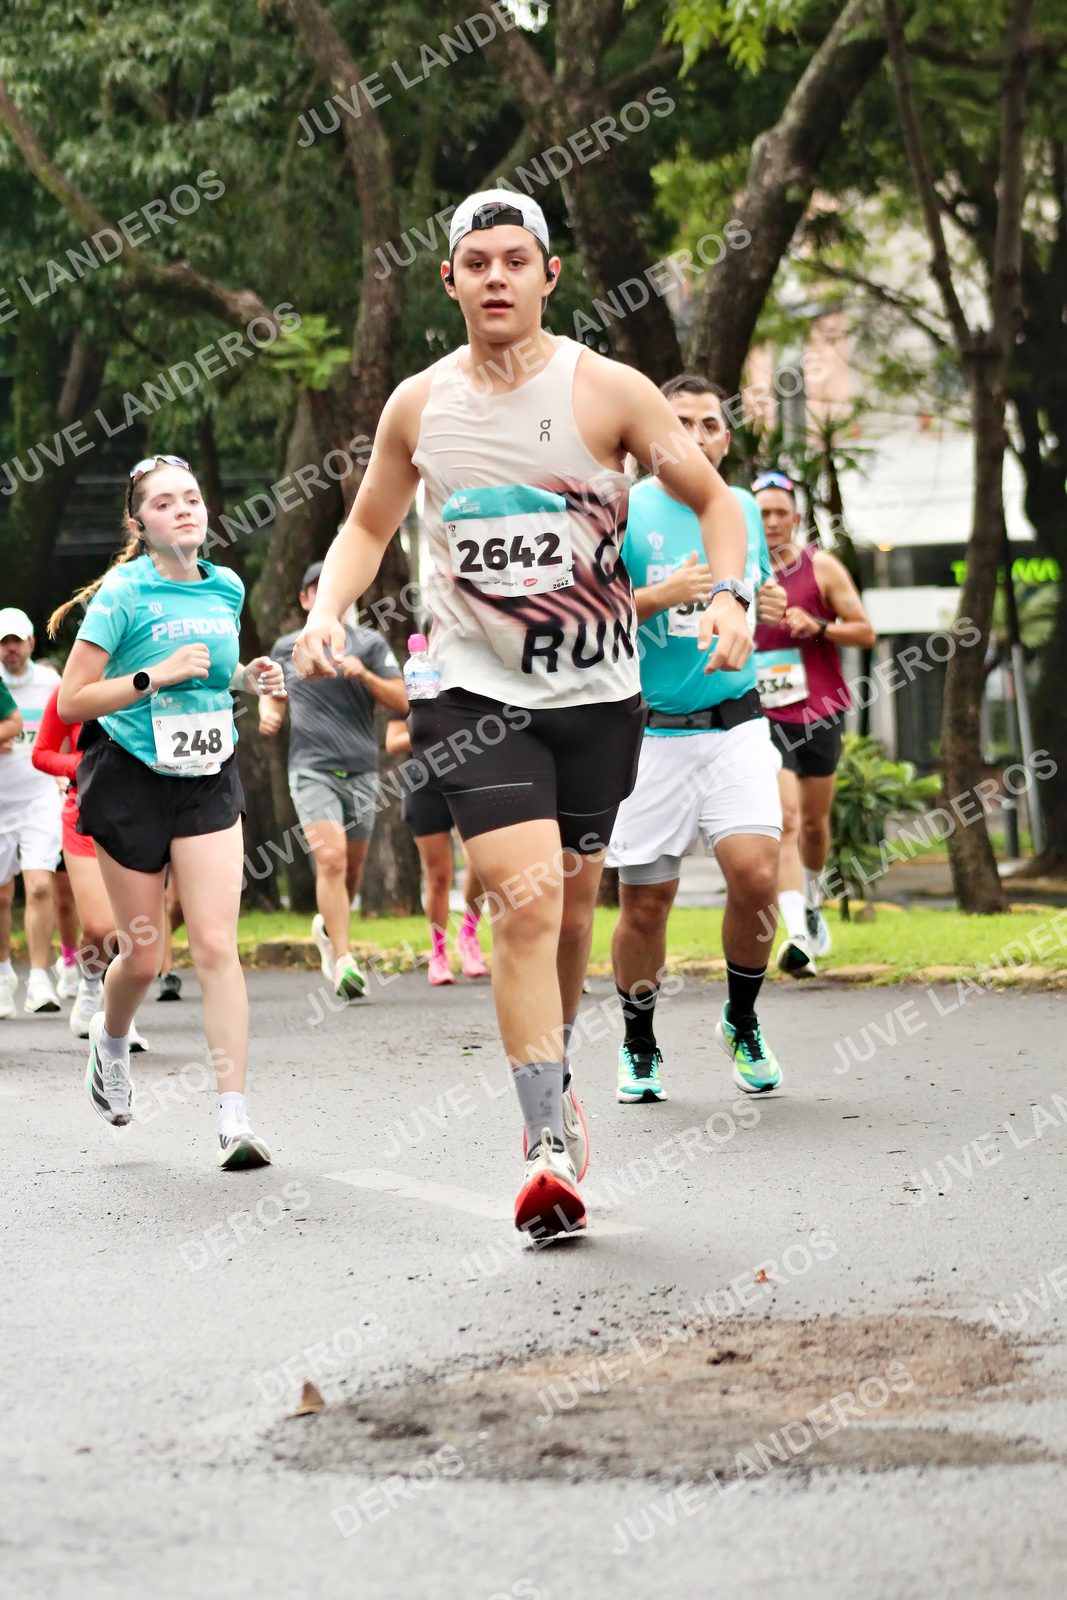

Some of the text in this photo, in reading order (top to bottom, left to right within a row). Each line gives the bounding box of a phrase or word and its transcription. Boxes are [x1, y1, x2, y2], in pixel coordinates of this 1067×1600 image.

[456, 532, 563, 573] 2642
[553, 580, 569, 589] 2642
[171, 728, 223, 758] 248
